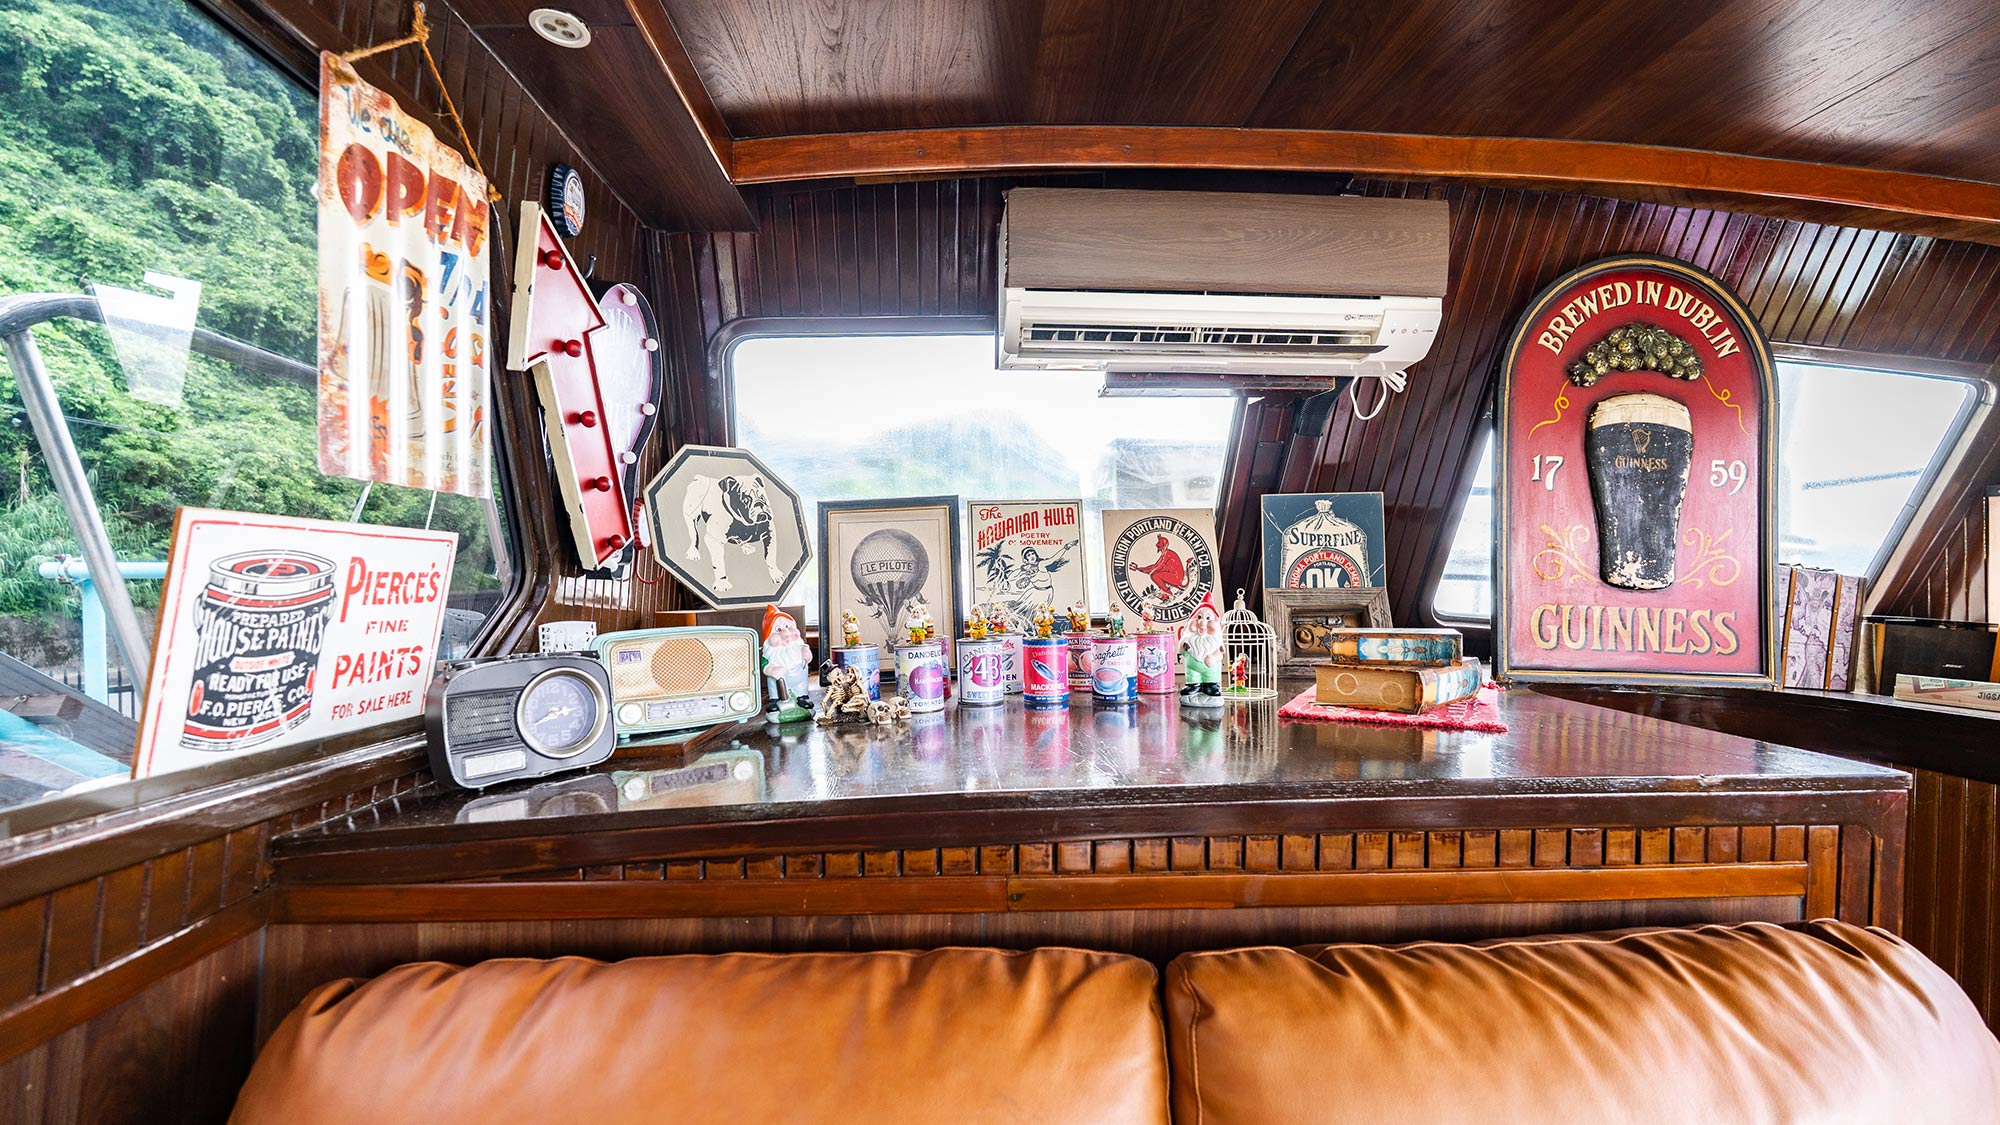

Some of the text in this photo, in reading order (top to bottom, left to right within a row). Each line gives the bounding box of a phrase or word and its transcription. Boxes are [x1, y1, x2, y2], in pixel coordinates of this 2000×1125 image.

[337, 142, 487, 258] OPEN
[1537, 280, 1740, 359] BREWED IN DUBLIN
[1531, 454, 1748, 496] 17 59
[1614, 455, 1668, 471] GUINNESS
[979, 506, 1003, 520] The
[976, 507, 1075, 550] HAWAIIAN HULA
[1114, 537, 1131, 567] UNION
[1128, 519, 1172, 541] PORTLAND
[1172, 521, 1204, 555] CEMENT
[1288, 527, 1362, 547] SUPERFINE
[866, 561, 913, 572] LE PILOTE
[1304, 551, 1345, 565] PORTLAND
[340, 556, 441, 623] PIERCE'S
[1306, 567, 1342, 588] OK
[232, 610, 305, 628] PREPARED
[365, 619, 410, 634] FINE
[1530, 603, 1740, 656] GUINNESS
[195, 607, 265, 671] HOUSE
[209, 671, 255, 692] READY
[255, 669, 280, 690] FOR
[281, 661, 307, 684] USE
[332, 645, 423, 689] PAINTS
[974, 656, 1000, 681] 43
[331, 690, 412, 720] FOR SALE HERE
